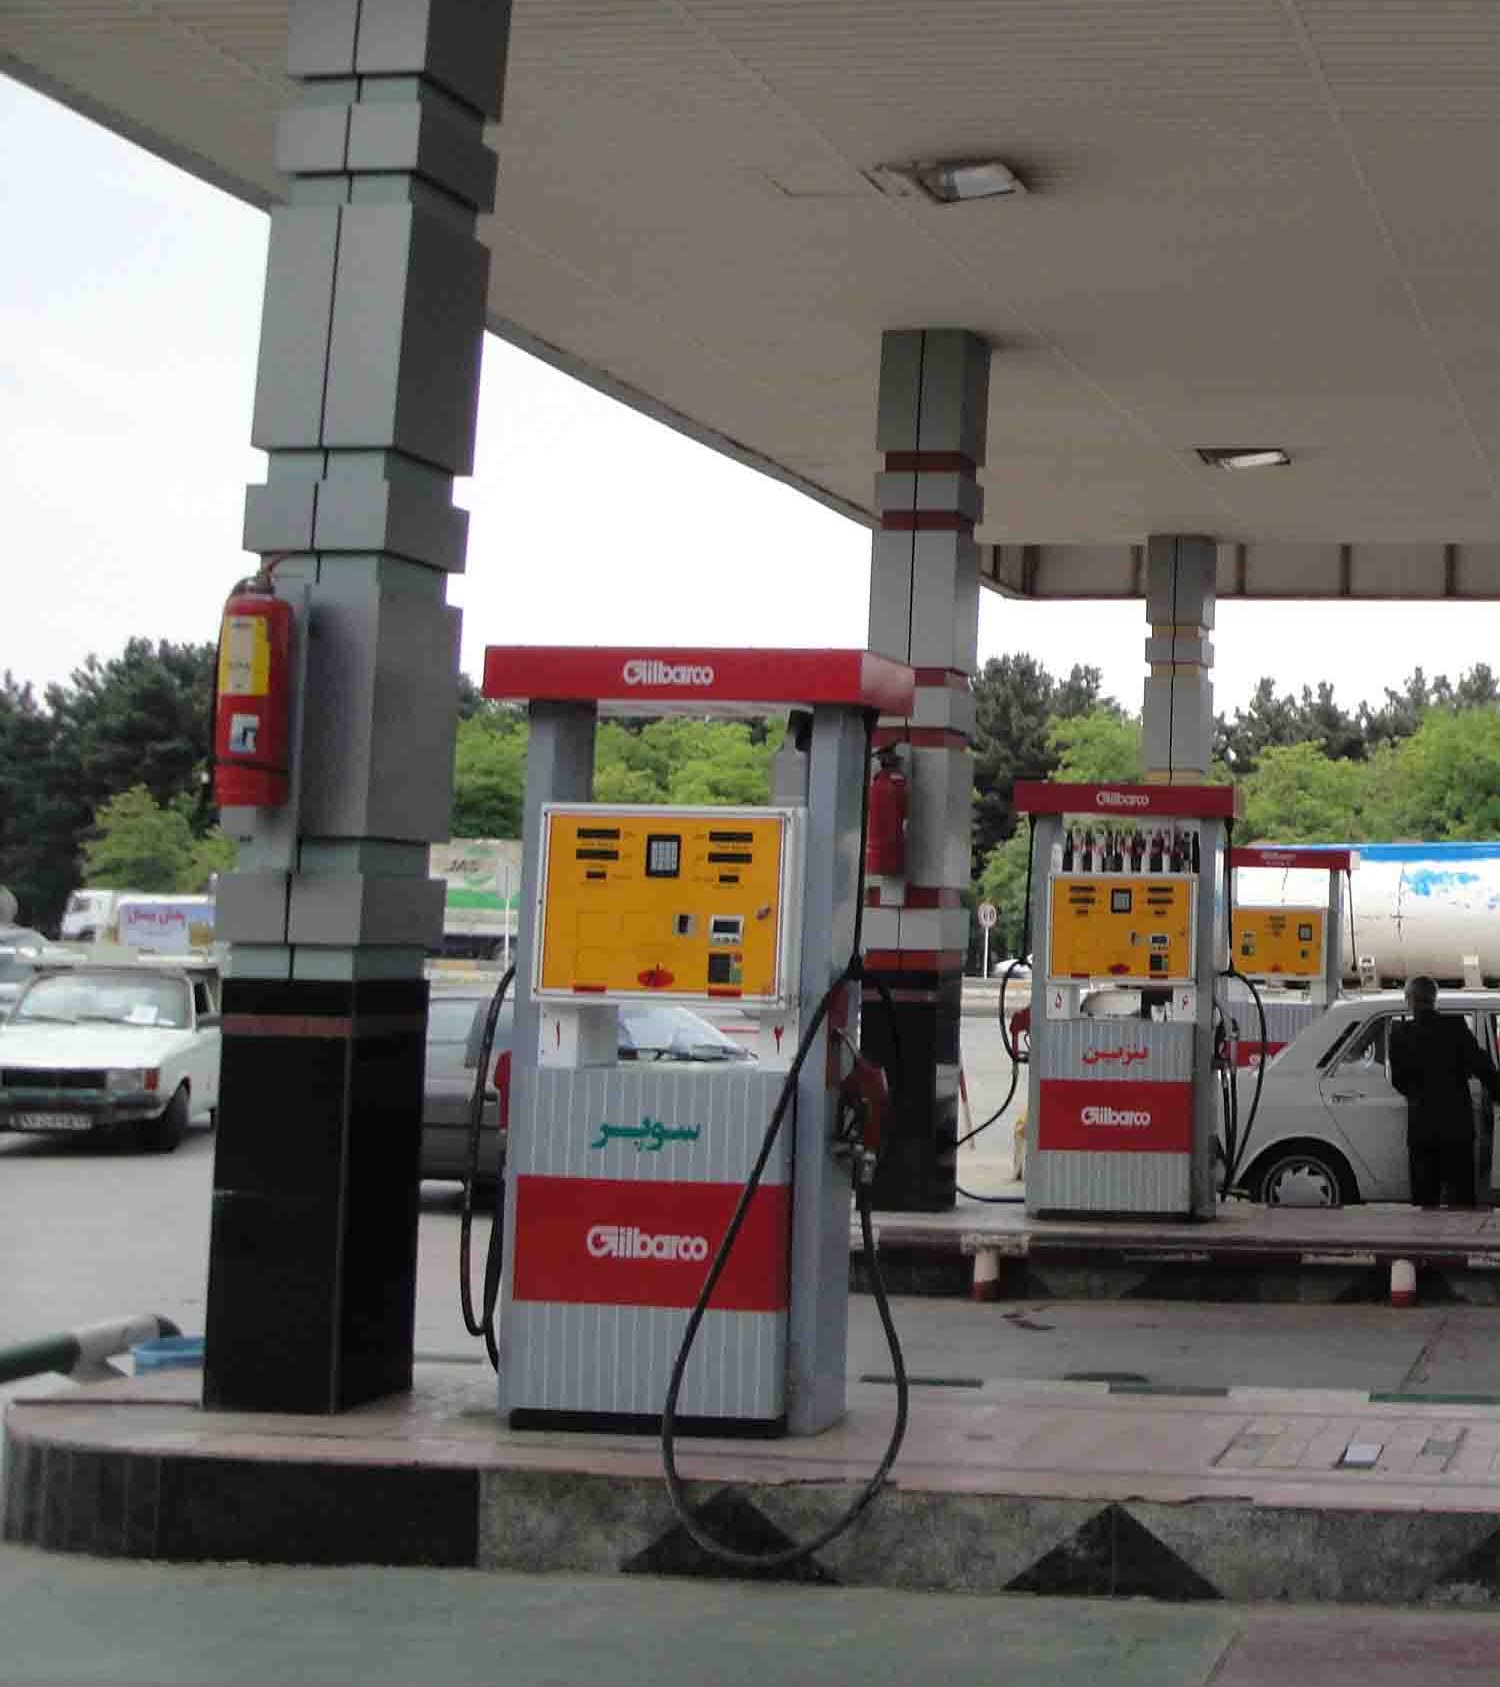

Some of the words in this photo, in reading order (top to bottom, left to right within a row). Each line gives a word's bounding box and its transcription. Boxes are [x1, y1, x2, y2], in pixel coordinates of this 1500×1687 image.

[624, 659, 714, 685] Gilbarco
[1096, 791, 1150, 806] Gilbarco
[1081, 1106, 1151, 1126] Gilbarco
[591, 1117, 702, 1151] سوپر
[587, 1225, 708, 1261] Gilbarco
